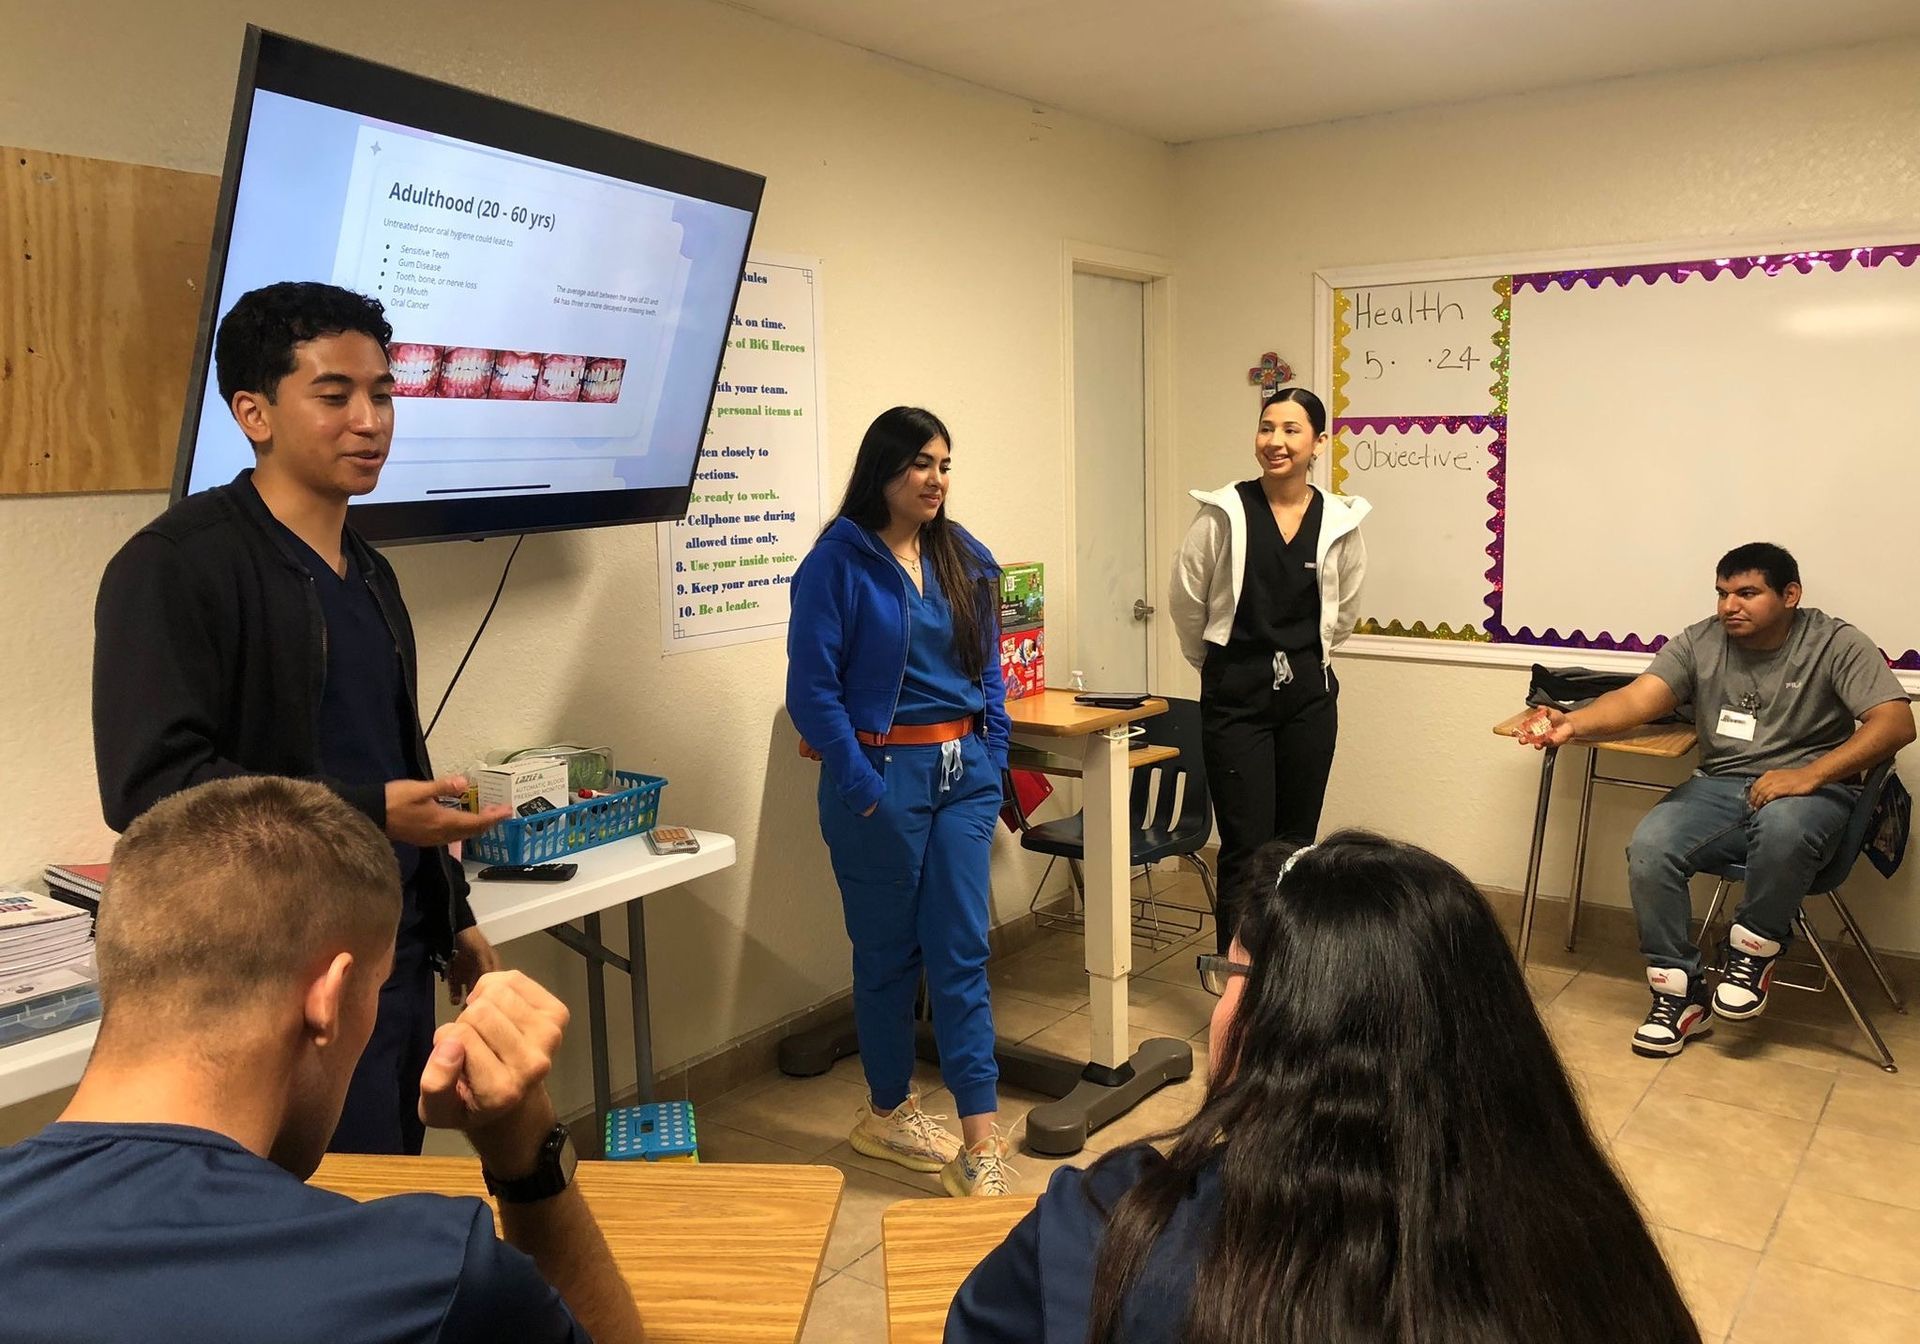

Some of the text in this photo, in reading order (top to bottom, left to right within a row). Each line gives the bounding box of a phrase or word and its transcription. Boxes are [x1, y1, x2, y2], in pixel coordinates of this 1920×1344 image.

[388, 181, 475, 215] Adulthood
[477, 199, 500, 219] (20
[511, 206, 528, 224] 60
[528, 212, 556, 232] yrs)
[383, 218, 419, 232] Untreated
[419, 225, 436, 235] poor
[436, 227, 450, 236] oral
[450, 229, 475, 241] hygiene
[475, 234, 493, 244] could
[493, 236, 506, 246] lead
[400, 244, 450, 260] Sensitive Teeth
[398, 258, 442, 272] Gum Disease
[396, 271, 478, 290] Tooth, bone, or nerve loss
[392, 285, 429, 297] Dry Mouth
[390, 298, 430, 310] Oral Cancer
[1355, 290, 1464, 330] Health
[745, 318, 758, 327] on
[761, 317, 786, 330] time.
[735, 338, 746, 349] of
[749, 338, 769, 351] BiG
[771, 340, 805, 353] Heroes
[735, 385, 758, 396] your
[761, 384, 788, 394] team.
[717, 405, 762, 418] personal
[764, 405, 791, 416] items
[793, 407, 803, 416] at
[700, 446, 769, 460] ten closely to
[705, 491, 734, 504] ready
[737, 491, 748, 501] to
[751, 489, 780, 500] work.
[688, 513, 741, 527] Cellphone
[743, 513, 761, 522] use
[763, 510, 796, 523] during
[685, 532, 779, 549] allowed time only.
[676, 552, 797, 573] 8. Use your inside voice.
[677, 584, 688, 596] 9.
[691, 582, 719, 594] Keep
[721, 580, 745, 593] your
[747, 578, 770, 588] area
[679, 599, 760, 618] 10. Be a leader.
